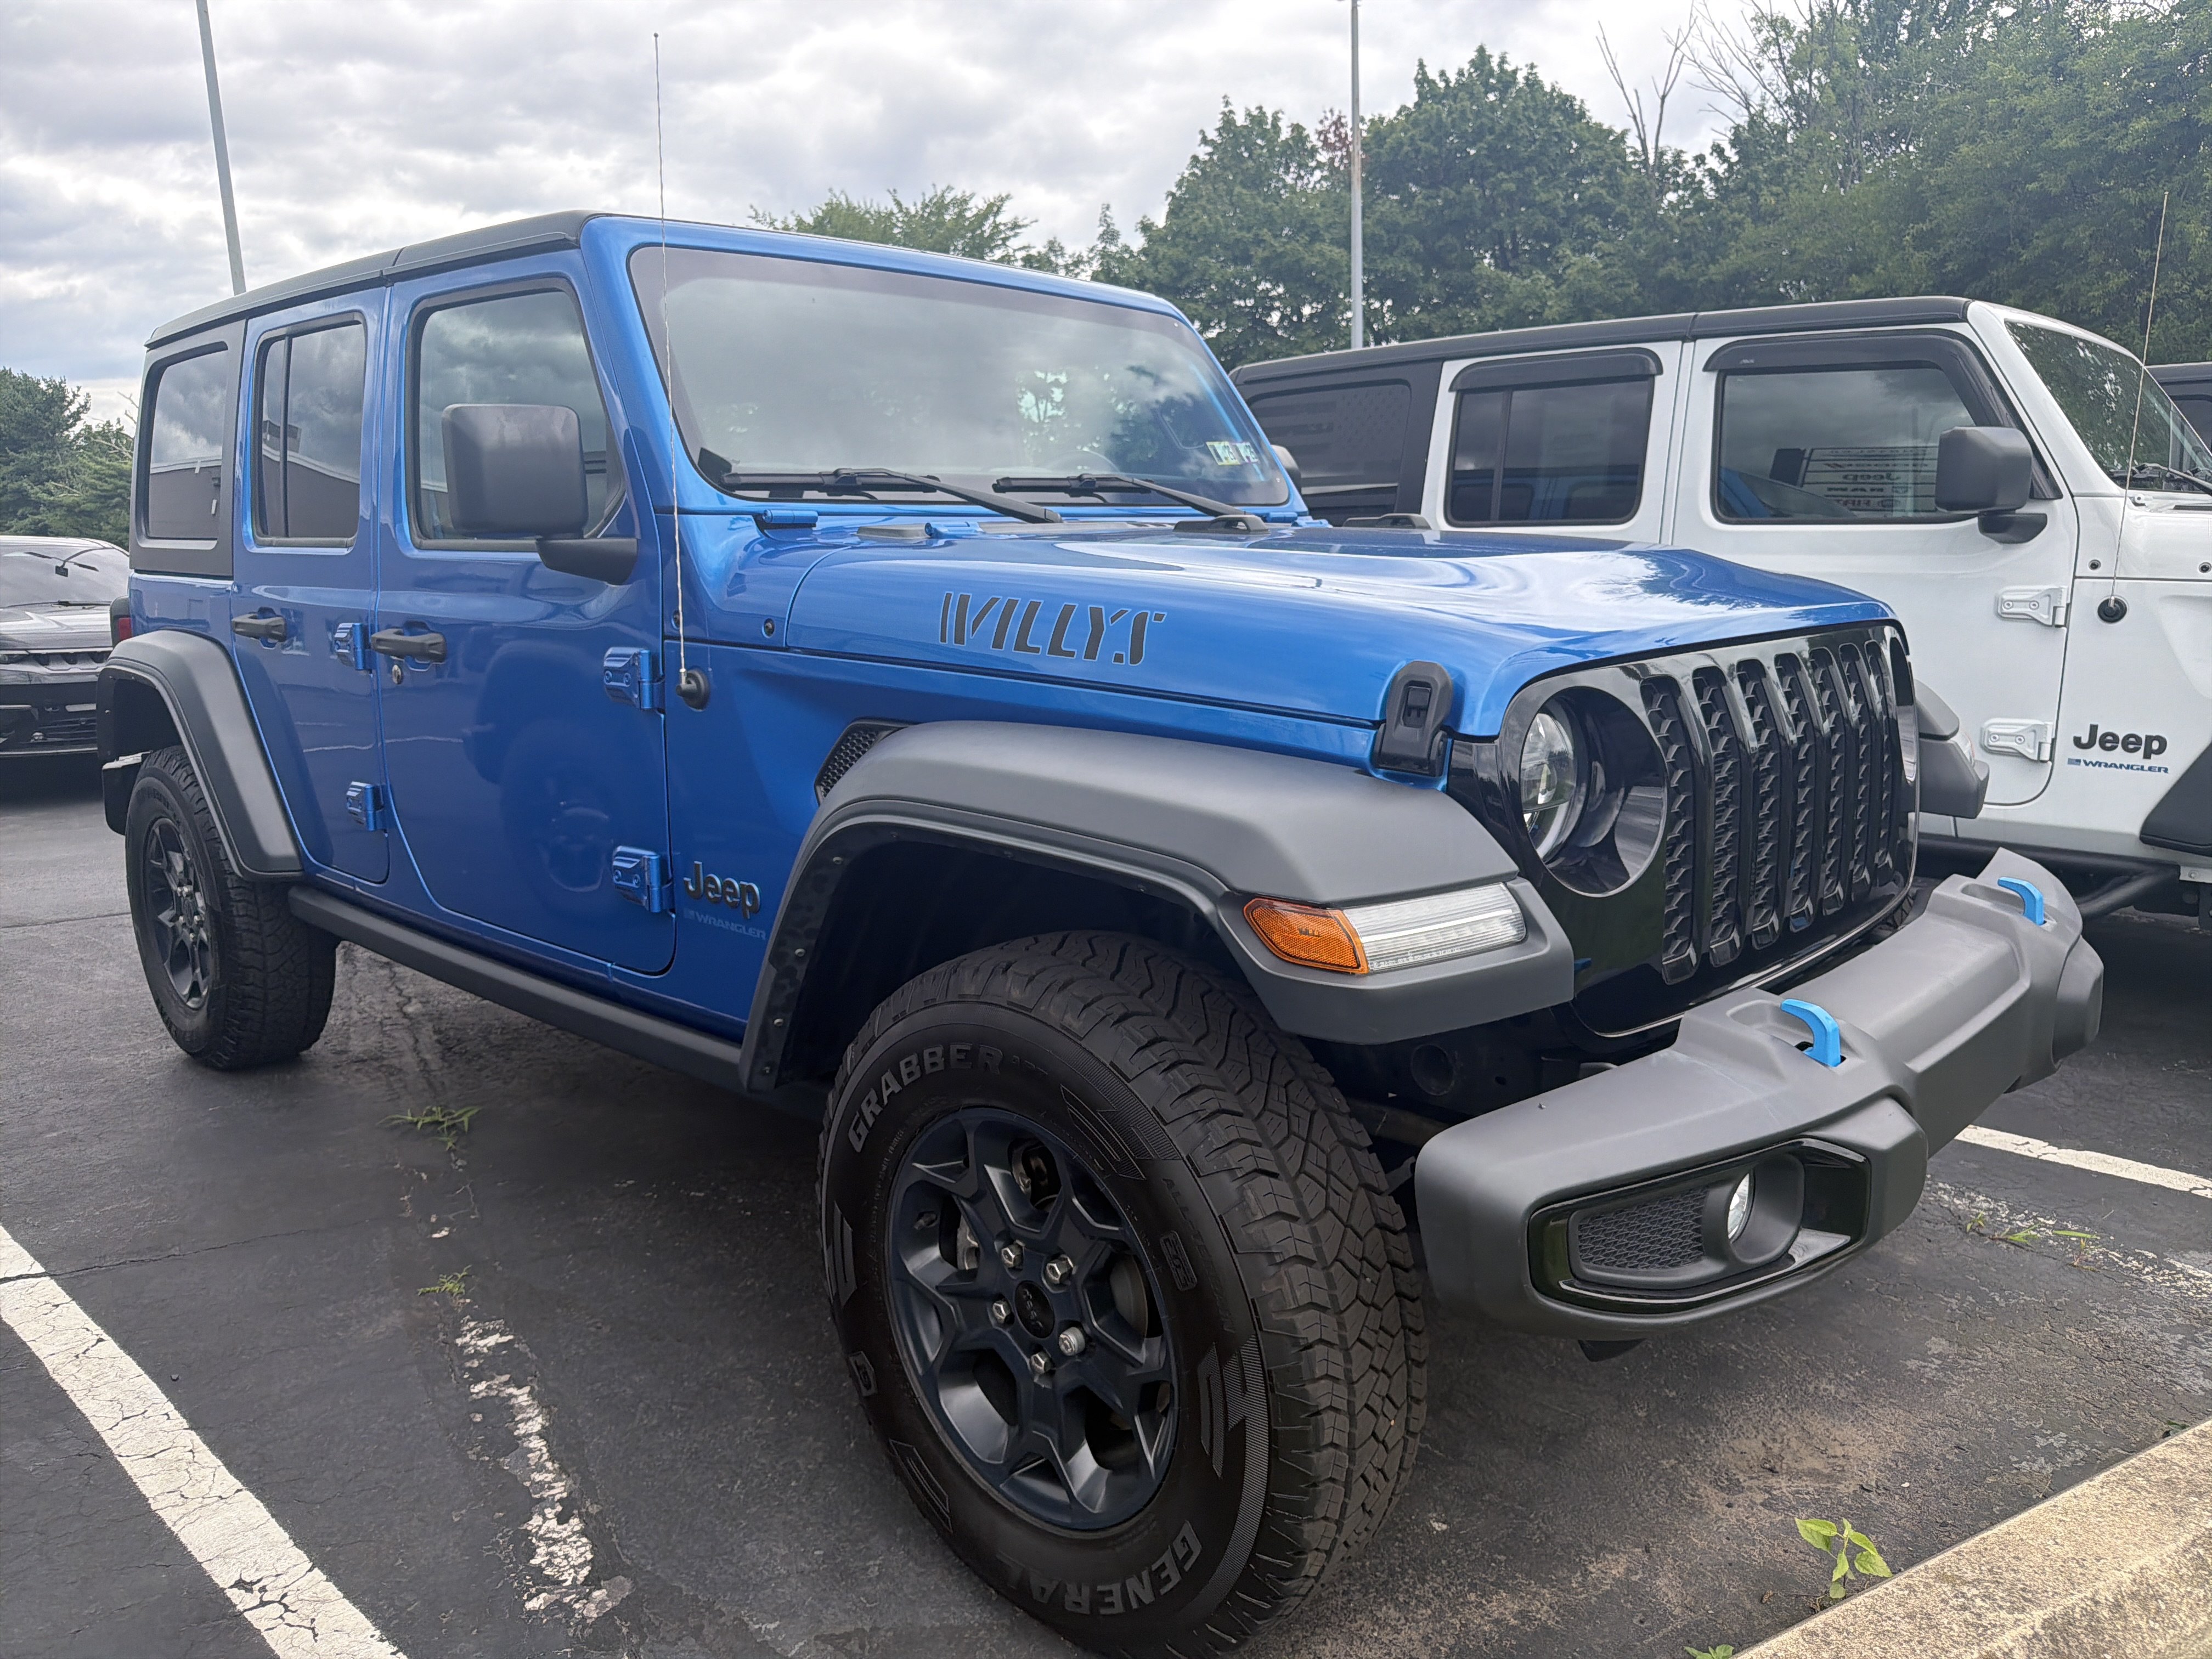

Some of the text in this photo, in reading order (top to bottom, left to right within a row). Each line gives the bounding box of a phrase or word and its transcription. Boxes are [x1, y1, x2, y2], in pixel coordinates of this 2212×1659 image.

[939, 591, 1167, 665] WILLYS
[2073, 723, 2168, 760] Jeep
[2083, 760, 2169, 773] WRANGLER
[683, 860, 761, 920] Jeep
[695, 911, 766, 940] WRANGLER
[848, 1043, 1005, 1153] GRABBER
[996, 1519, 1203, 1615] GENERAL
